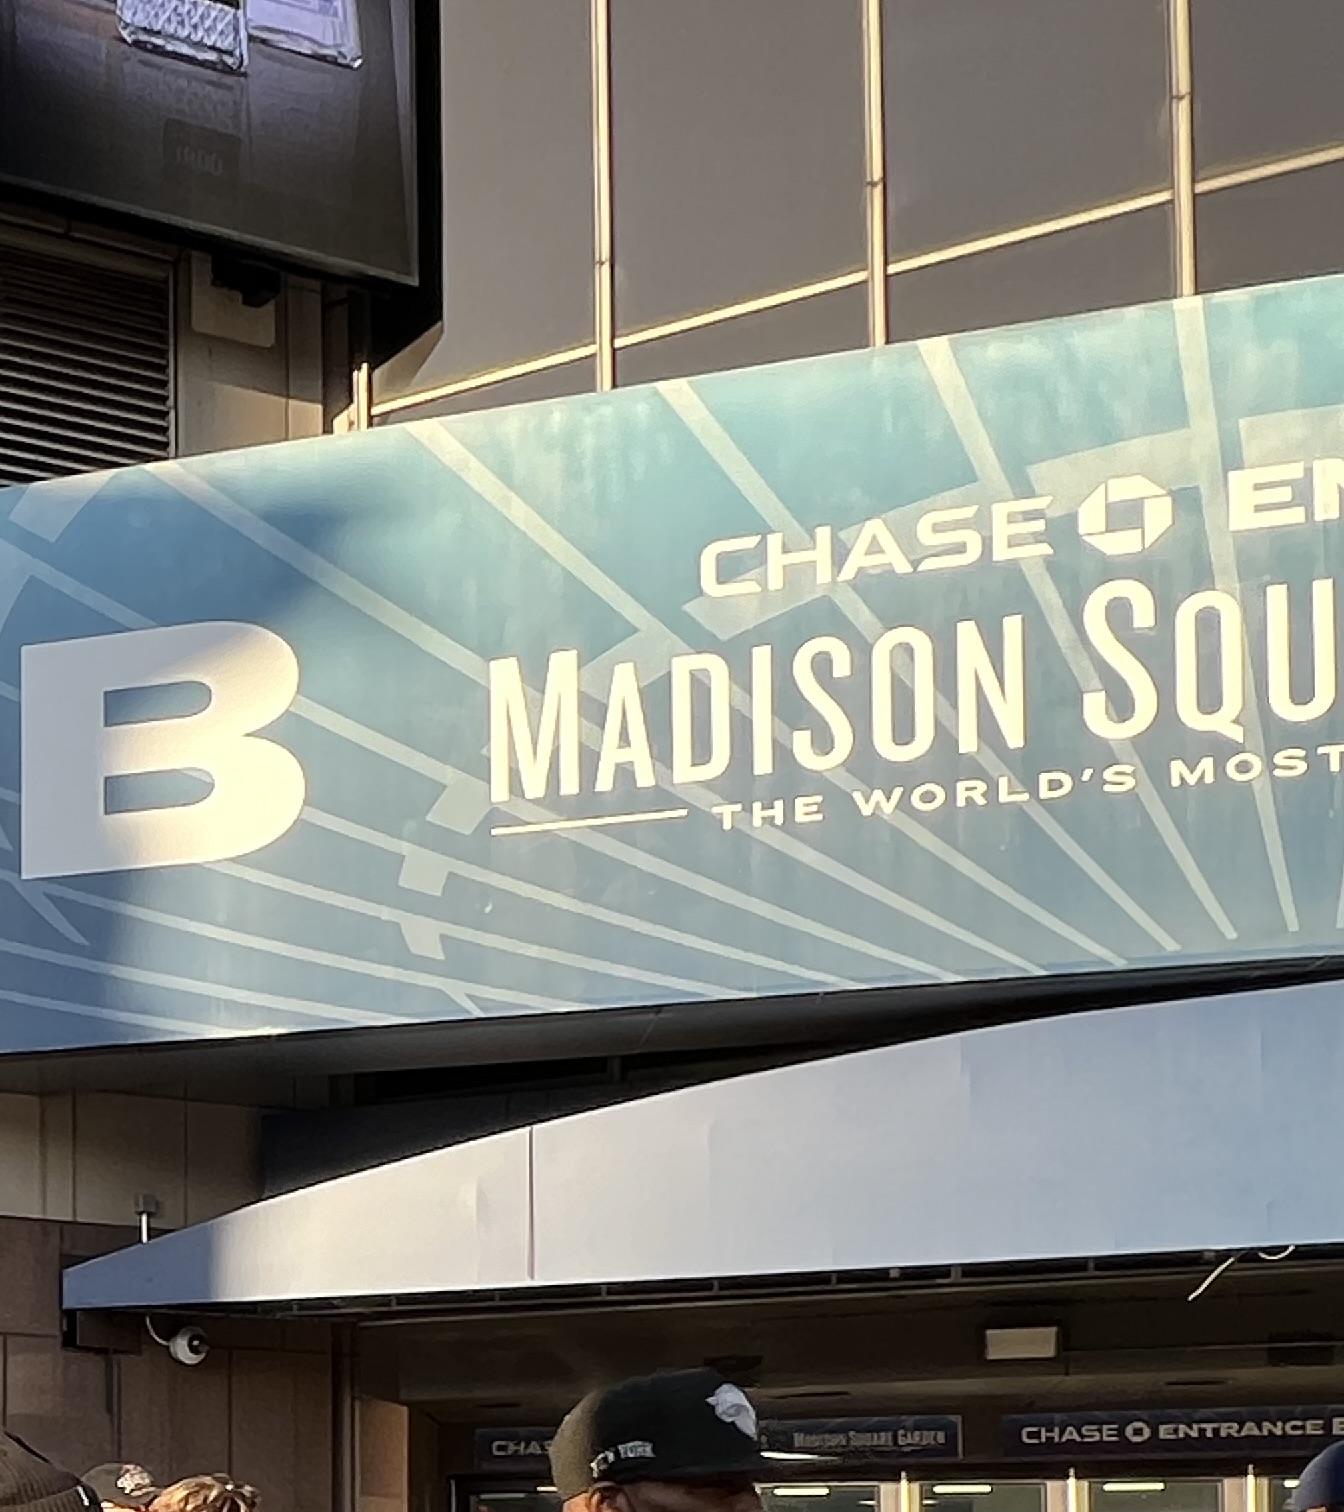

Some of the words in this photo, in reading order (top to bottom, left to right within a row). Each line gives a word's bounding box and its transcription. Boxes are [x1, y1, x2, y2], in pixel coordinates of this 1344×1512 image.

[700, 496, 1054, 599] CHASE
[488, 614, 1026, 804] MADISON
[1082, 578, 1337, 744] SQU
[20, 620, 306, 880] B
[712, 795, 824, 831] THE
[852, 765, 1137, 817] WORLD'S
[1170, 742, 1344, 788] MOST
[897, 1429, 946, 1446] GARDEN
[1020, 1424, 1120, 1444] CHASE
[1159, 1419, 1325, 1439] ENTRANCE
